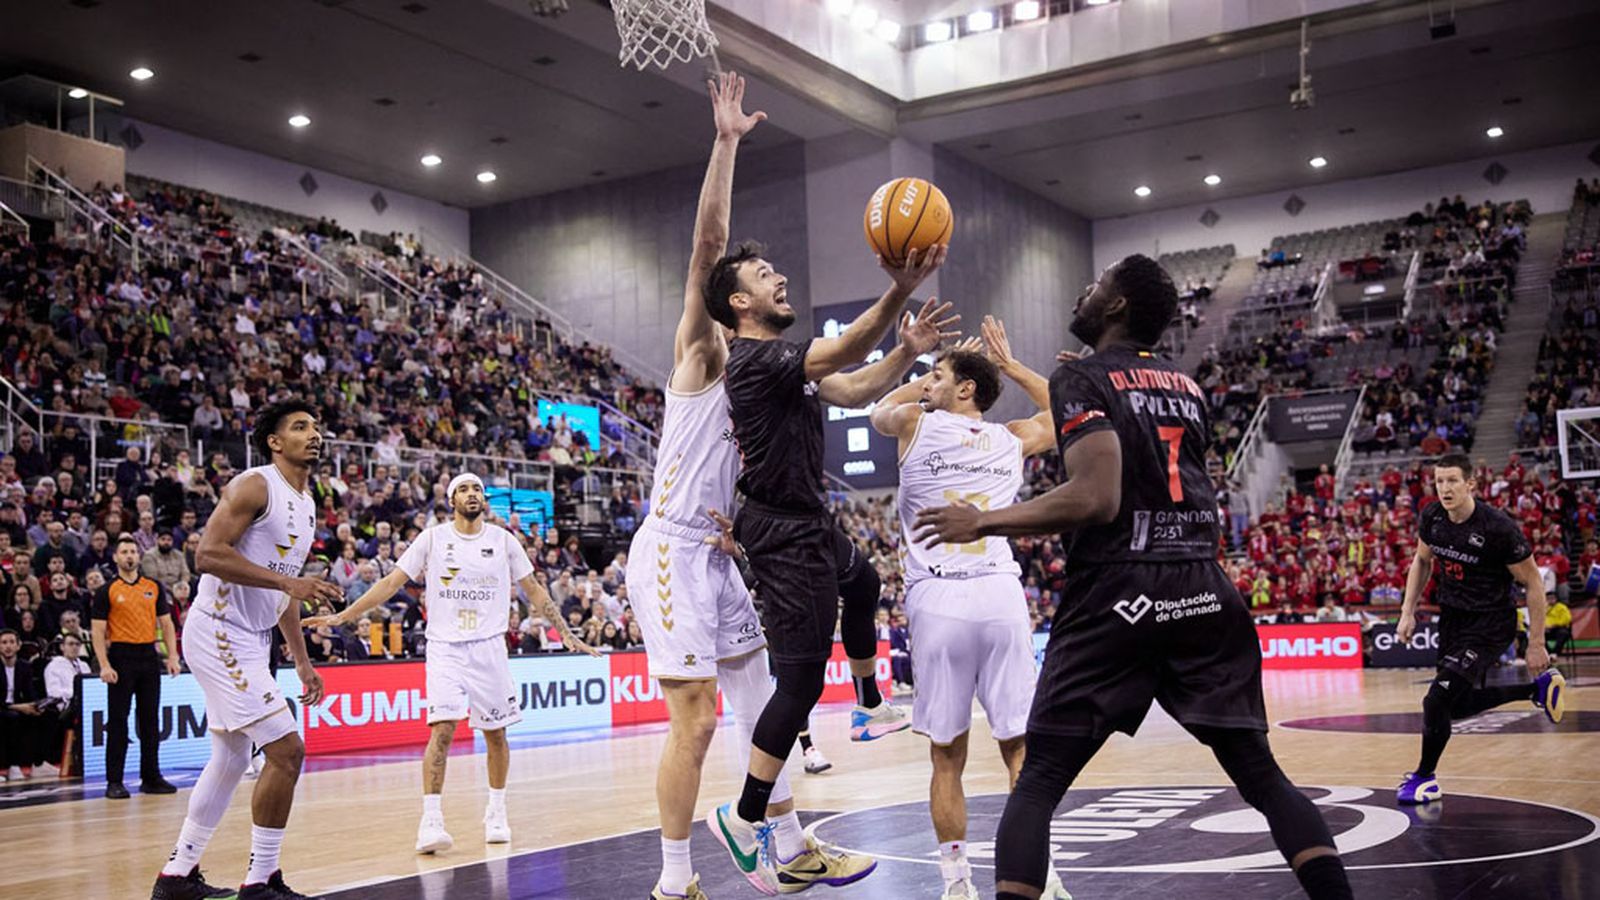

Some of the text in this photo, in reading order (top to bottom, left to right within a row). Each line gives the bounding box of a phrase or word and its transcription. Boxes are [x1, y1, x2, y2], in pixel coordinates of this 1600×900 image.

[1157, 426, 1185, 502] 7
[1154, 592, 1217, 612] Diputación
[1155, 602, 1222, 623] de Granada
[1260, 636, 1359, 659] UMHO
[308, 688, 429, 729] KUMH
